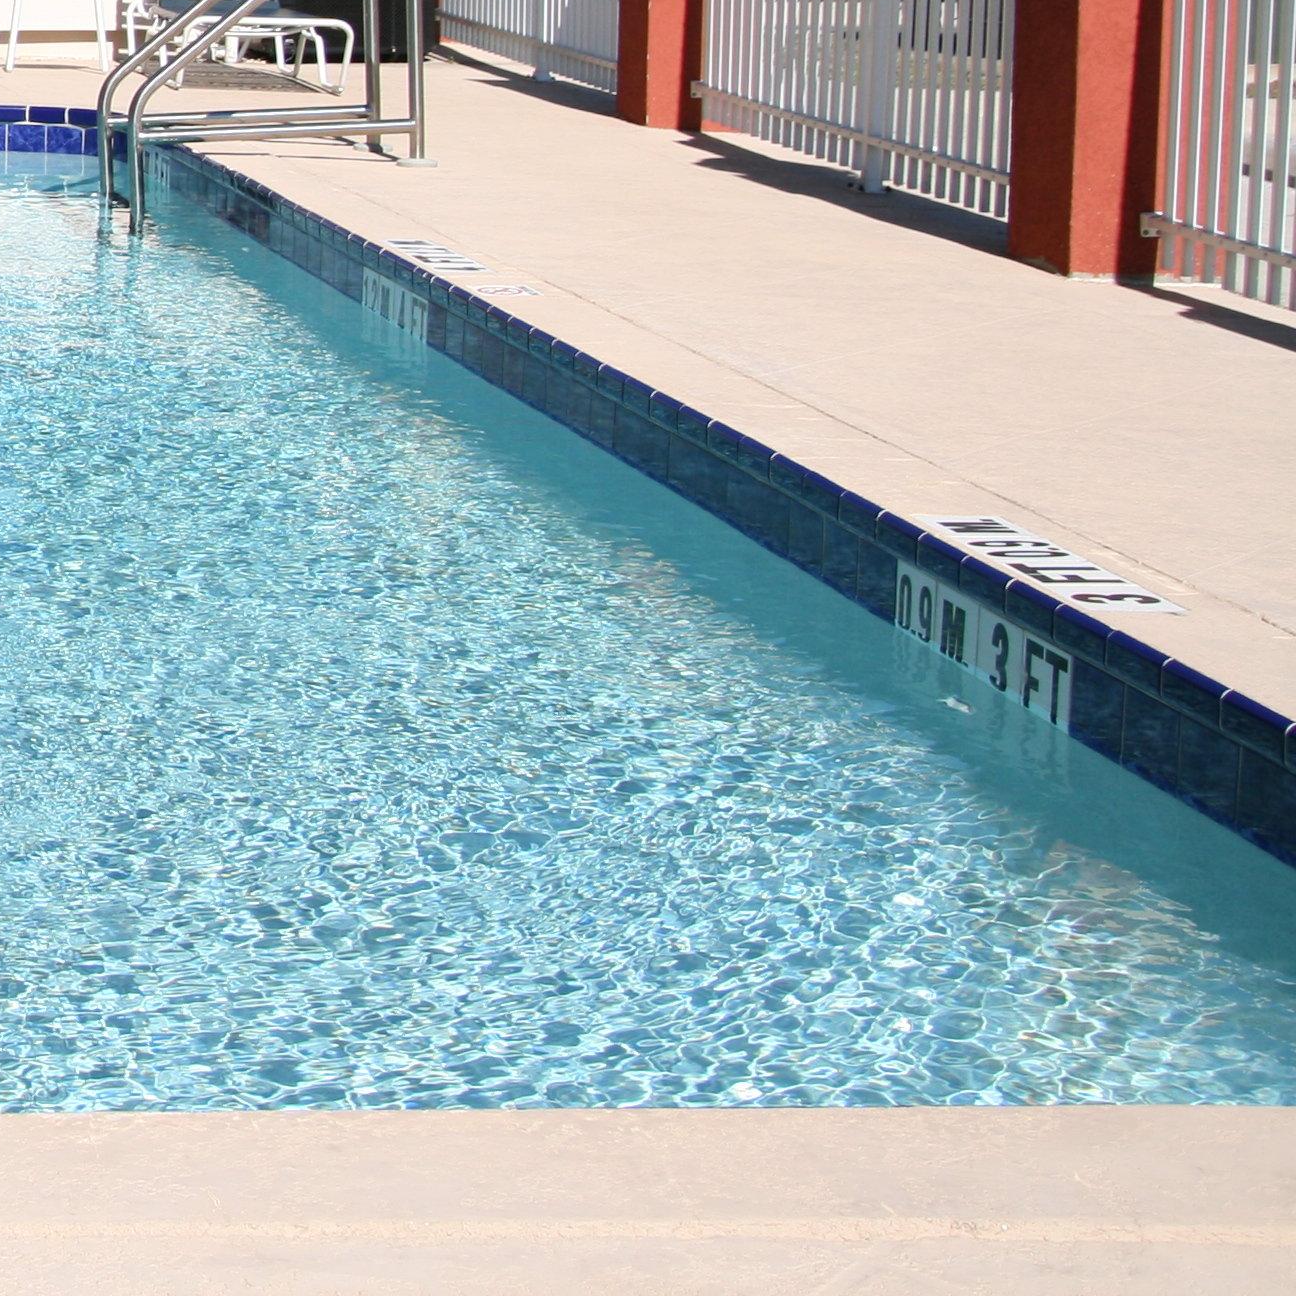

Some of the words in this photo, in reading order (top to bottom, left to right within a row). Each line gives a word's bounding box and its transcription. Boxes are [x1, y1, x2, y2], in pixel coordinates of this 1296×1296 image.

[411, 296, 427, 340] FT
[1009, 563, 1126, 584] FT
[1070, 593, 1160, 605] 3
[989, 622, 1009, 692] 3
[1022, 638, 1068, 725] FT
